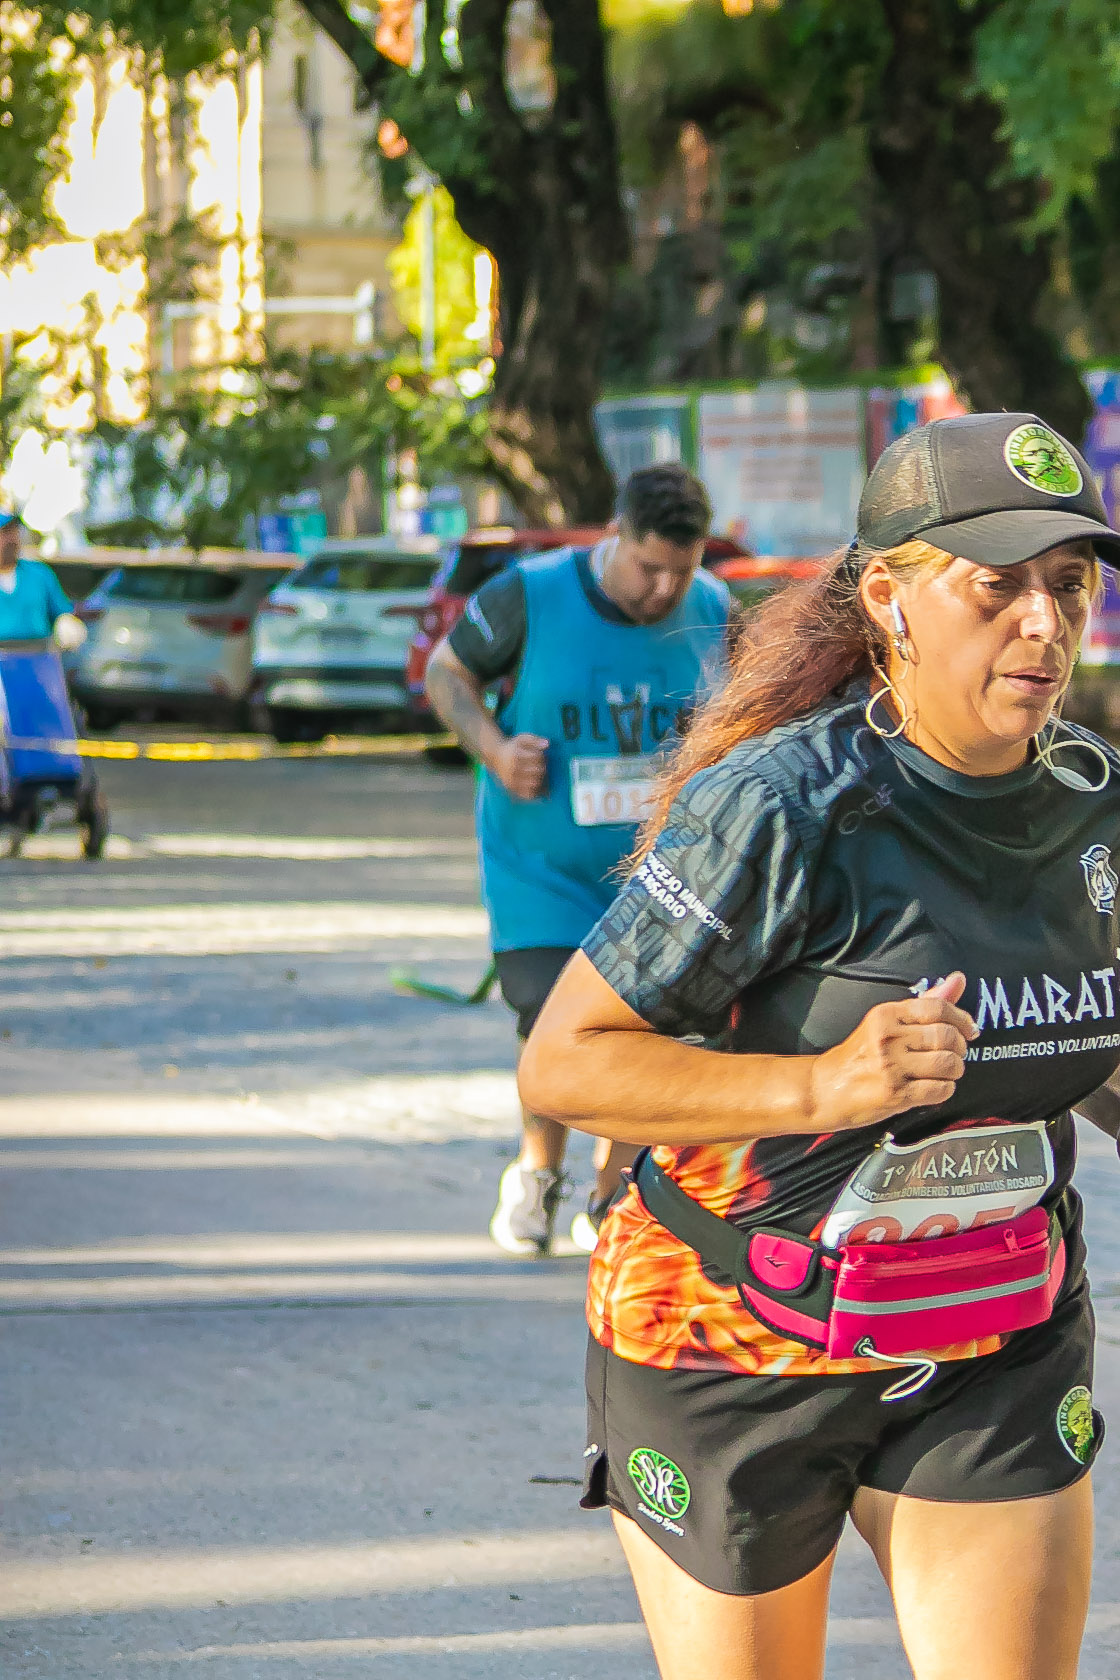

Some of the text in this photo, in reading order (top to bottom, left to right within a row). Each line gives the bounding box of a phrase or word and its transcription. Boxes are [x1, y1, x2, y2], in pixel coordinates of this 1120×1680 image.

[678, 888, 733, 941] MUNICIPAL
[981, 1040, 1056, 1062] BOMBEROS
[905, 1139, 1019, 1183] MARATÓN
[901, 1185, 950, 1198] BOMBEROS
[950, 1180, 1007, 1197] VOLUNTARIOS
[1007, 1174, 1045, 1190] ROSARIO
